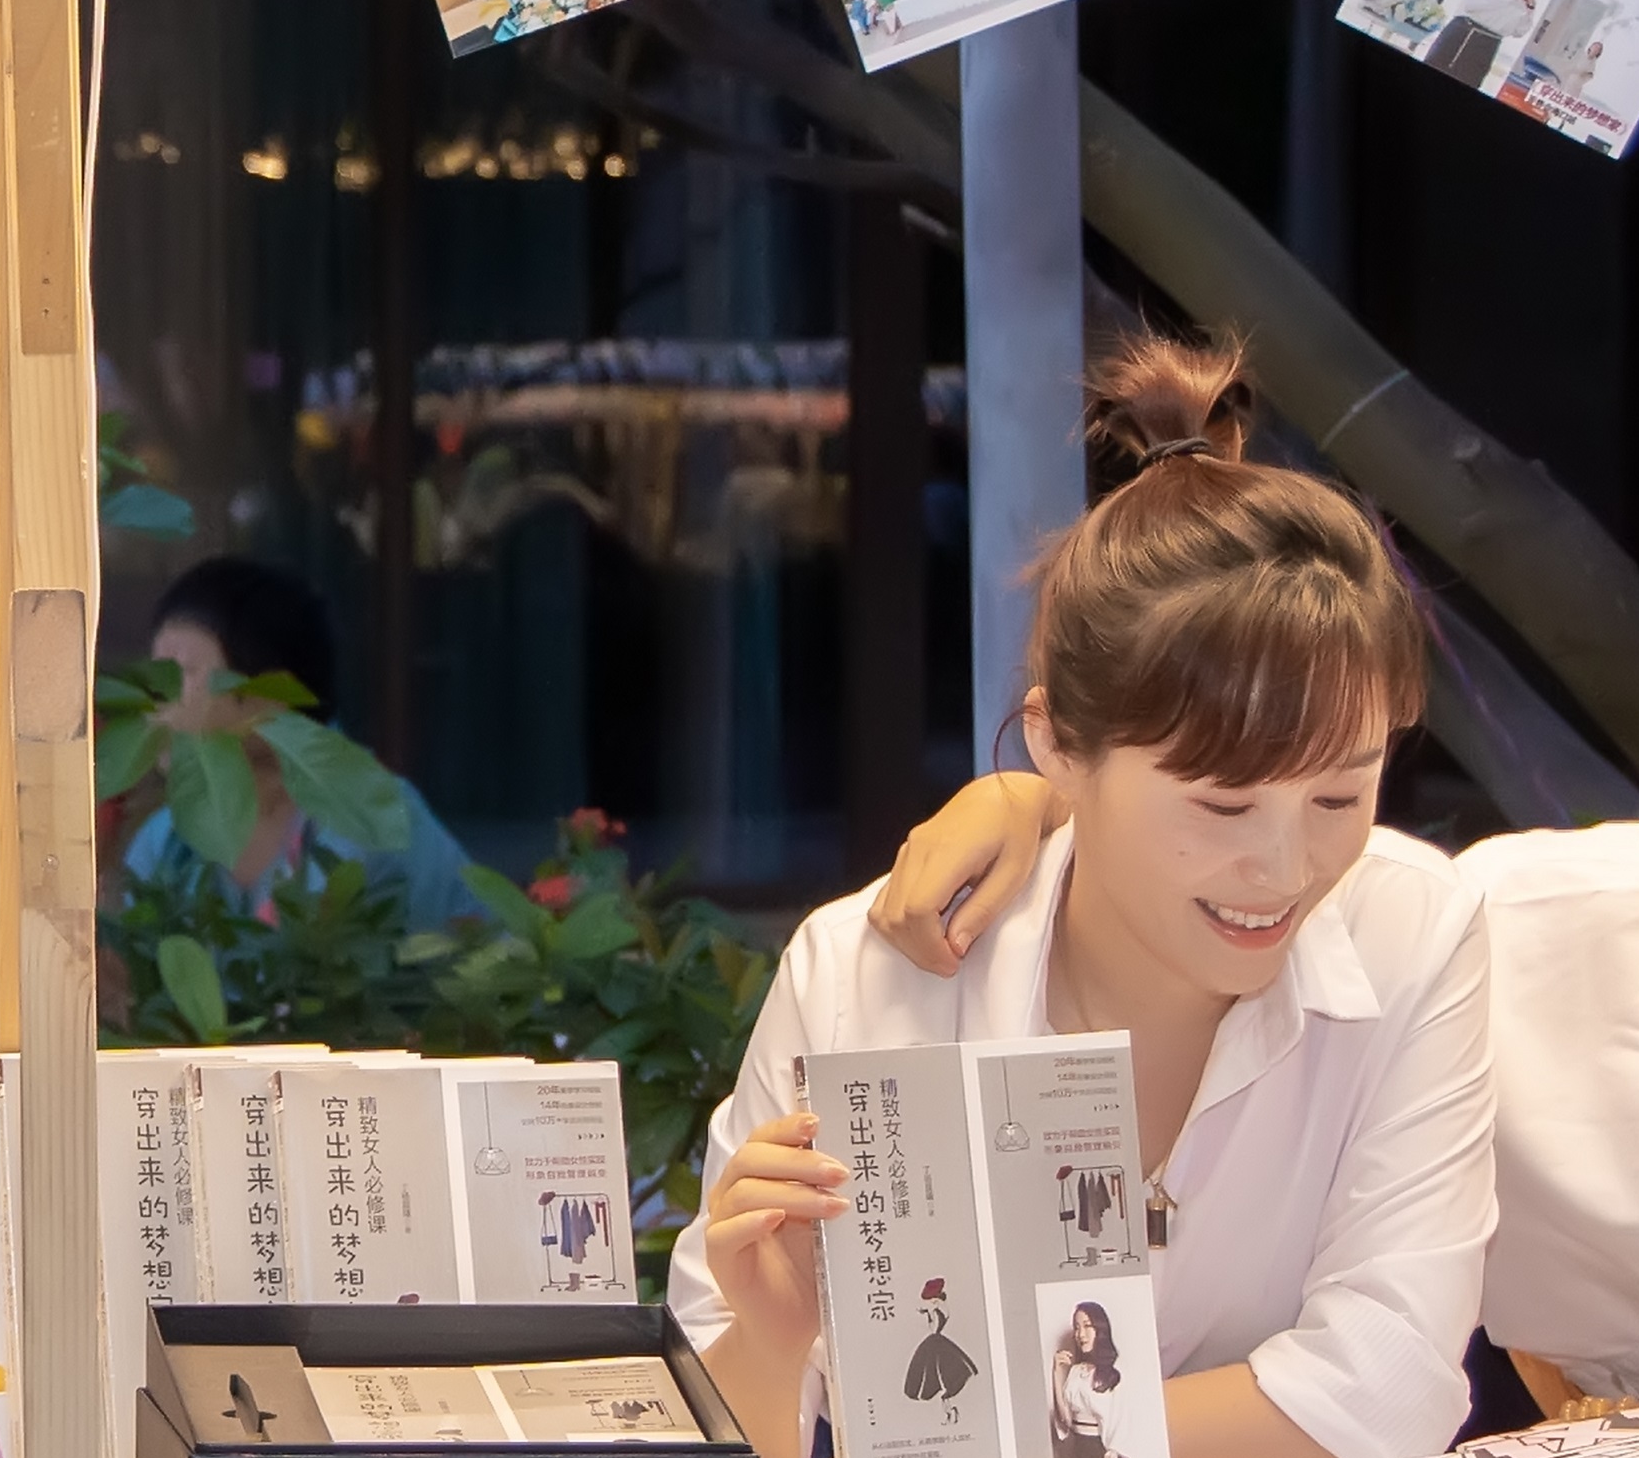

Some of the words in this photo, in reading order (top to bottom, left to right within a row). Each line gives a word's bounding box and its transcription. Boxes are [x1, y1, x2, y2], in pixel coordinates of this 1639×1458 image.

[357, 1096, 387, 1235] 精致女人必修课
[843, 1079, 897, 1323] 穿出来的梦想家
[878, 1077, 912, 1220] 精致女人必修课
